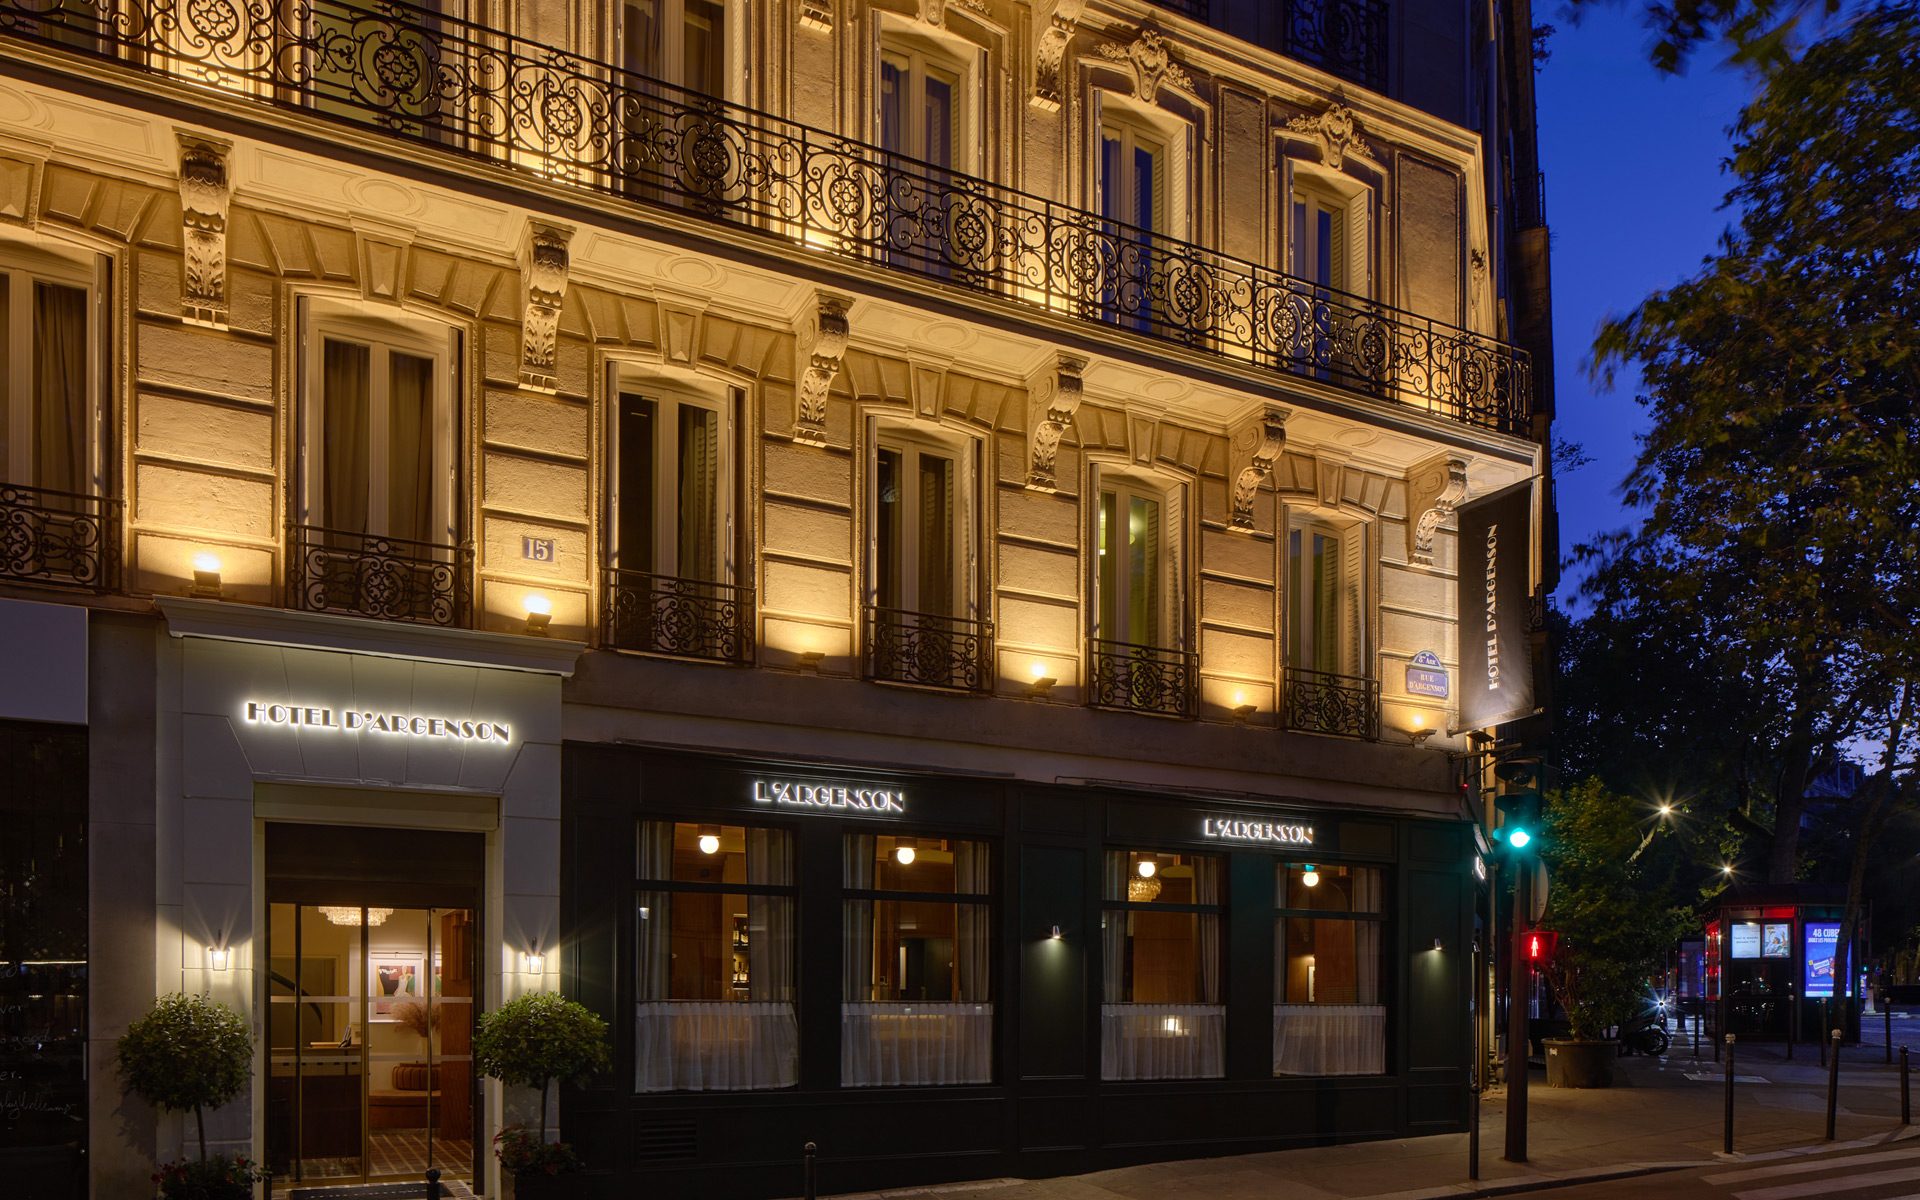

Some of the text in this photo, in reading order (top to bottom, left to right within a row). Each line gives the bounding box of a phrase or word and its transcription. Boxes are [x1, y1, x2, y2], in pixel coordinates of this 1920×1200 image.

[527, 538, 549, 560] 15
[1486, 524, 1500, 690] HOTEL D'ARGENSON
[1409, 680, 1446, 693] D'ARGENSON
[1420, 673, 1435, 683] RUE
[246, 701, 510, 744] HOTEL D'ARGENSON
[755, 781, 904, 812] L'ARGENSON
[1204, 818, 1314, 845] L'ARGENSON
[1813, 928, 1840, 937] 48 CUBE
